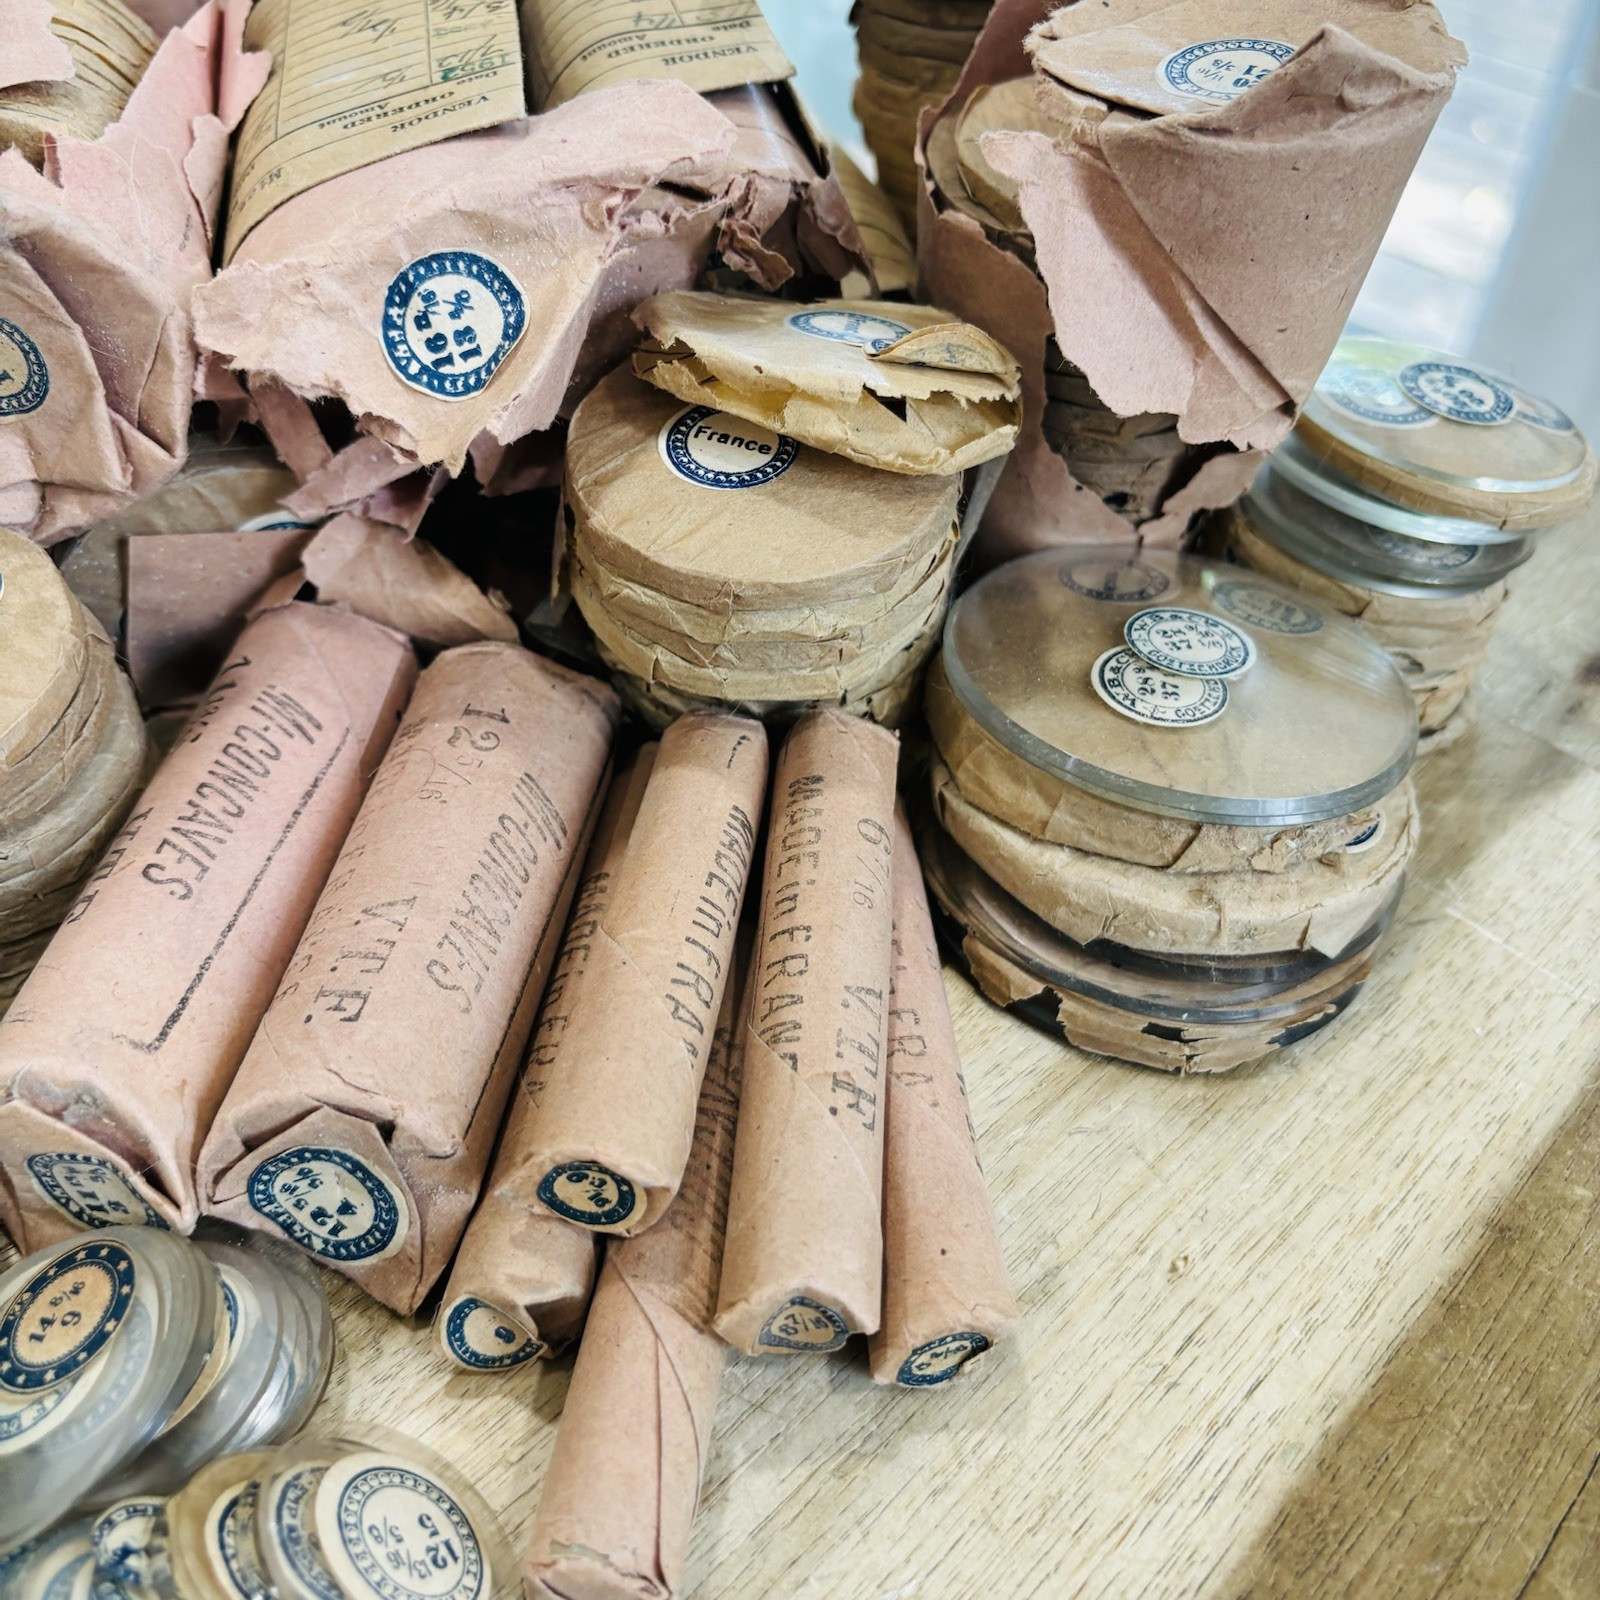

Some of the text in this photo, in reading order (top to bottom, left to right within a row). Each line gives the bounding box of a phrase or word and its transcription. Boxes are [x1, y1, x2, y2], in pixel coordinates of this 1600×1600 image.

[607, 35, 715, 59] ORDERED
[662, 44, 758, 66] VENDOR
[318, 70, 498, 129] Date Amount
[342, 91, 456, 130] ORDERED
[391, 95, 490, 132] VENDOR
[693, 424, 773, 457] France
[1137, 676, 1157, 697] 28
[1160, 680, 1181, 701] 37
[447, 702, 512, 752] 12
[776, 774, 825, 878] MADE
[857, 817, 891, 856] 6
[705, 804, 754, 917] MADE
[692, 895, 732, 938] in
[773, 878, 817, 921] in
[310, 1206, 348, 1237] 12
[29, 1312, 58, 1343] 14
[60, 1310, 82, 1327] 9
[367, 1512, 441, 1549] 5 5/8
[386, 1537, 460, 1580] 12 13/16
